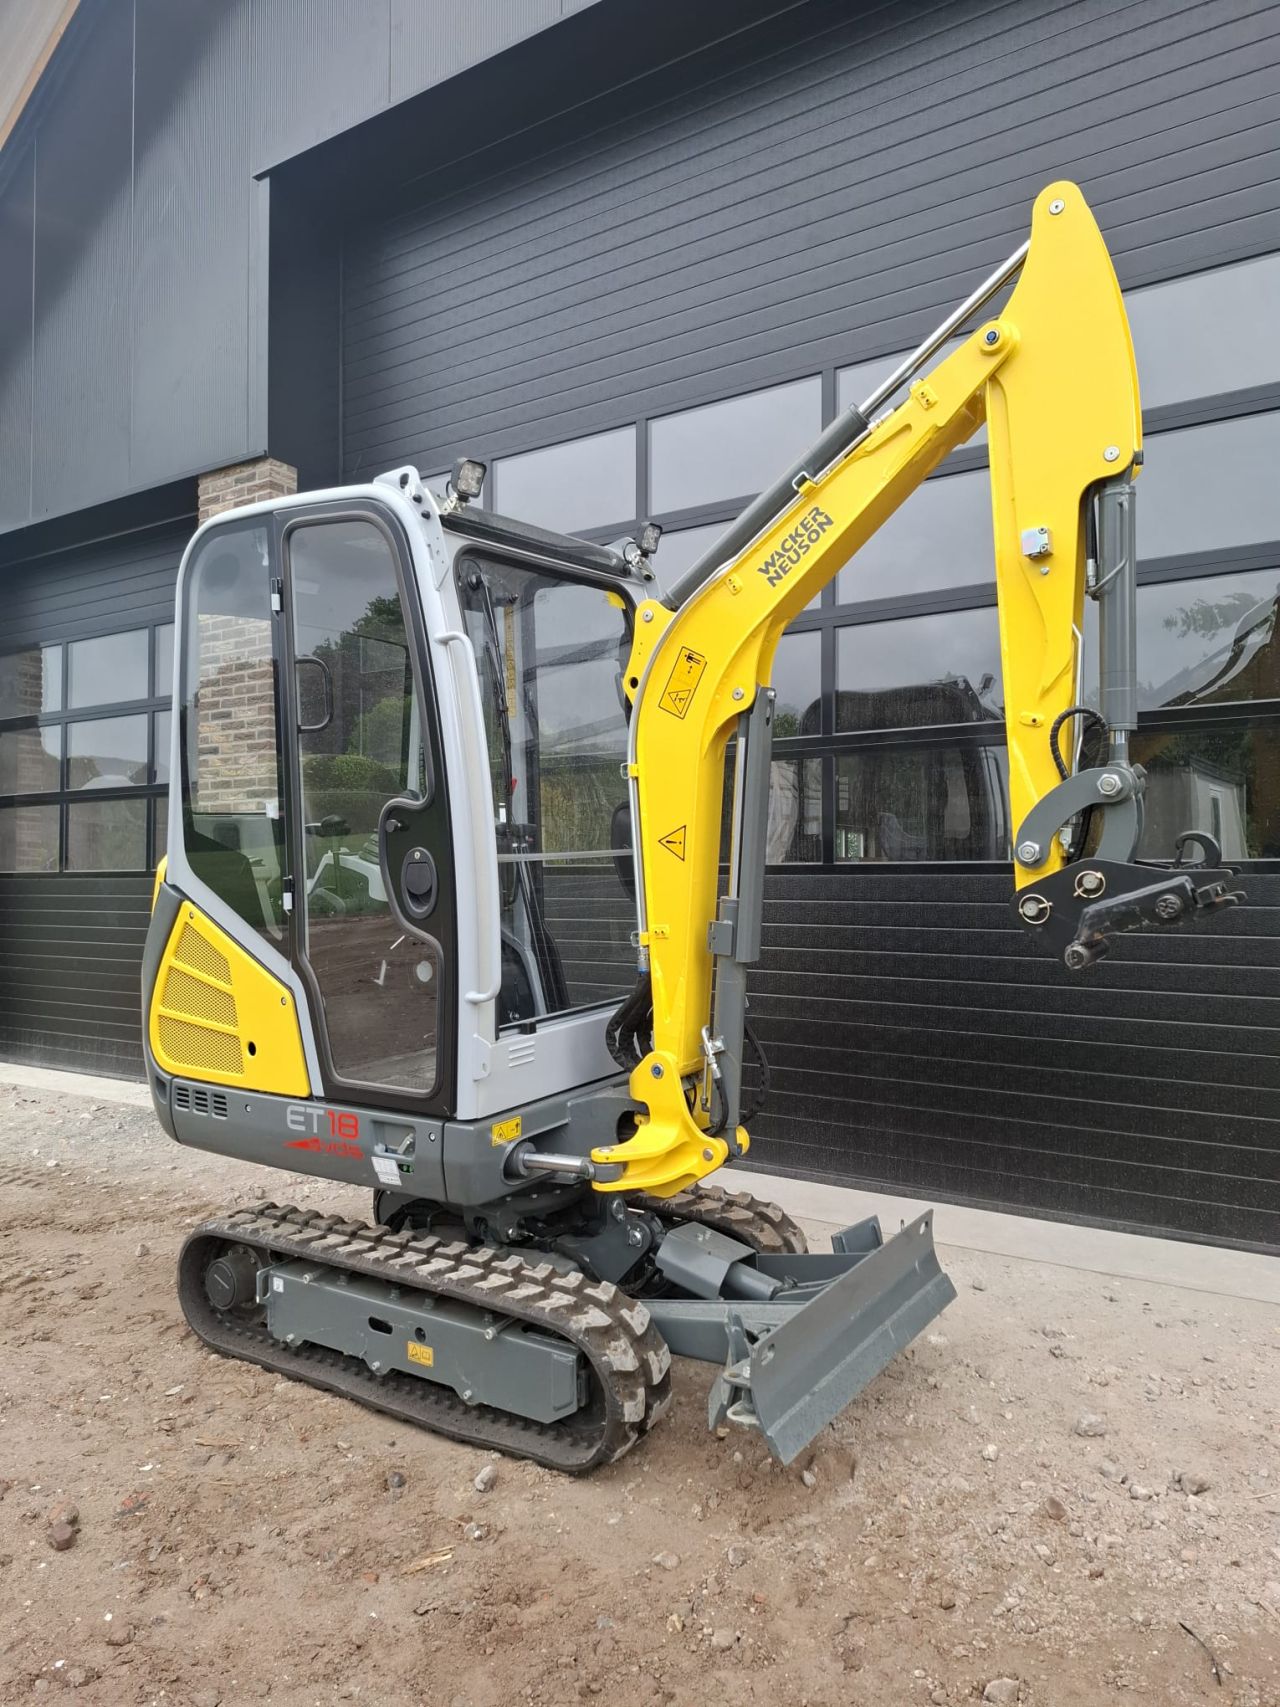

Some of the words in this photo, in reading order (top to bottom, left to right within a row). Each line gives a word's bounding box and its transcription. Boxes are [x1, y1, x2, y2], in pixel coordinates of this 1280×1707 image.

[757, 506, 825, 575] WACKER
[767, 514, 834, 588] NEUSON
[286, 1104, 359, 1140] ET18
